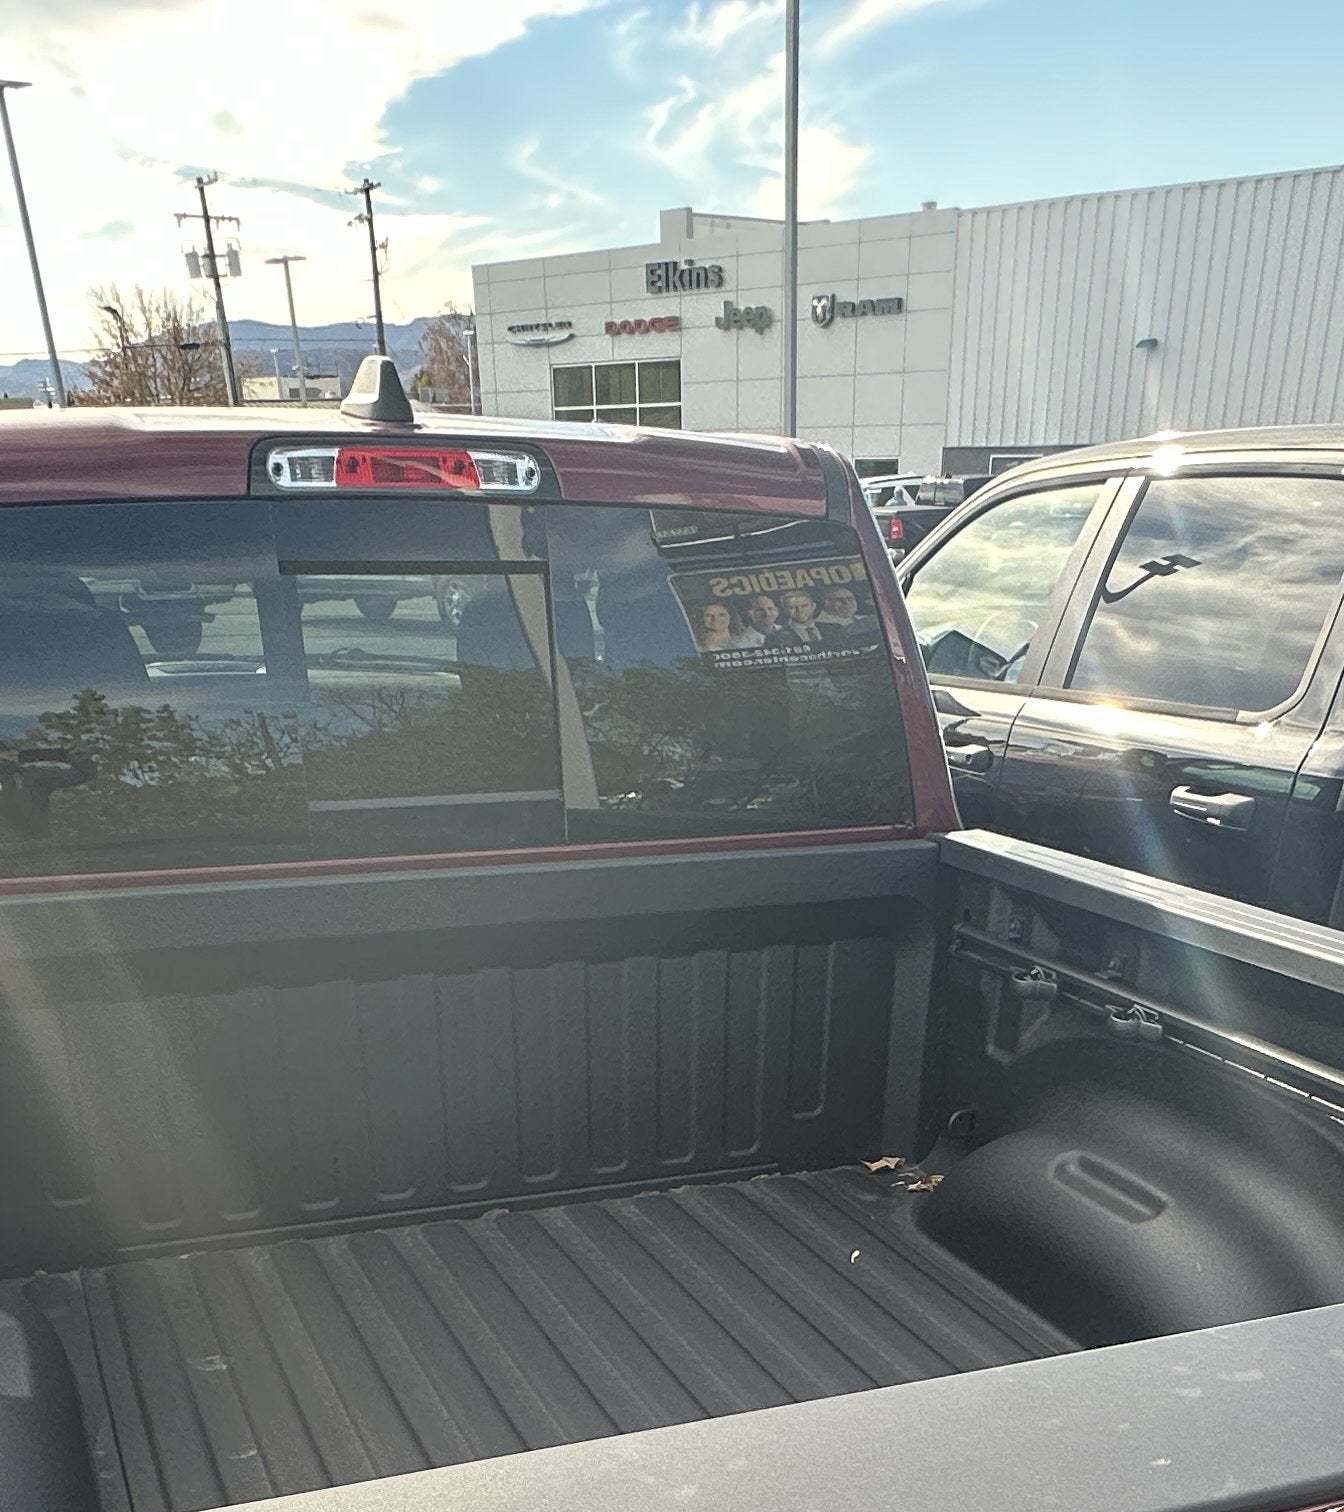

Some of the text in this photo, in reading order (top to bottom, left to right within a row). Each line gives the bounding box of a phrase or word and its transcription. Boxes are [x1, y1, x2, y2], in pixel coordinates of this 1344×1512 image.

[645, 259, 724, 294] Elkins
[714, 300, 773, 335] Jeep
[834, 297, 904, 318] RAM
[604, 315, 682, 336] DODGE
